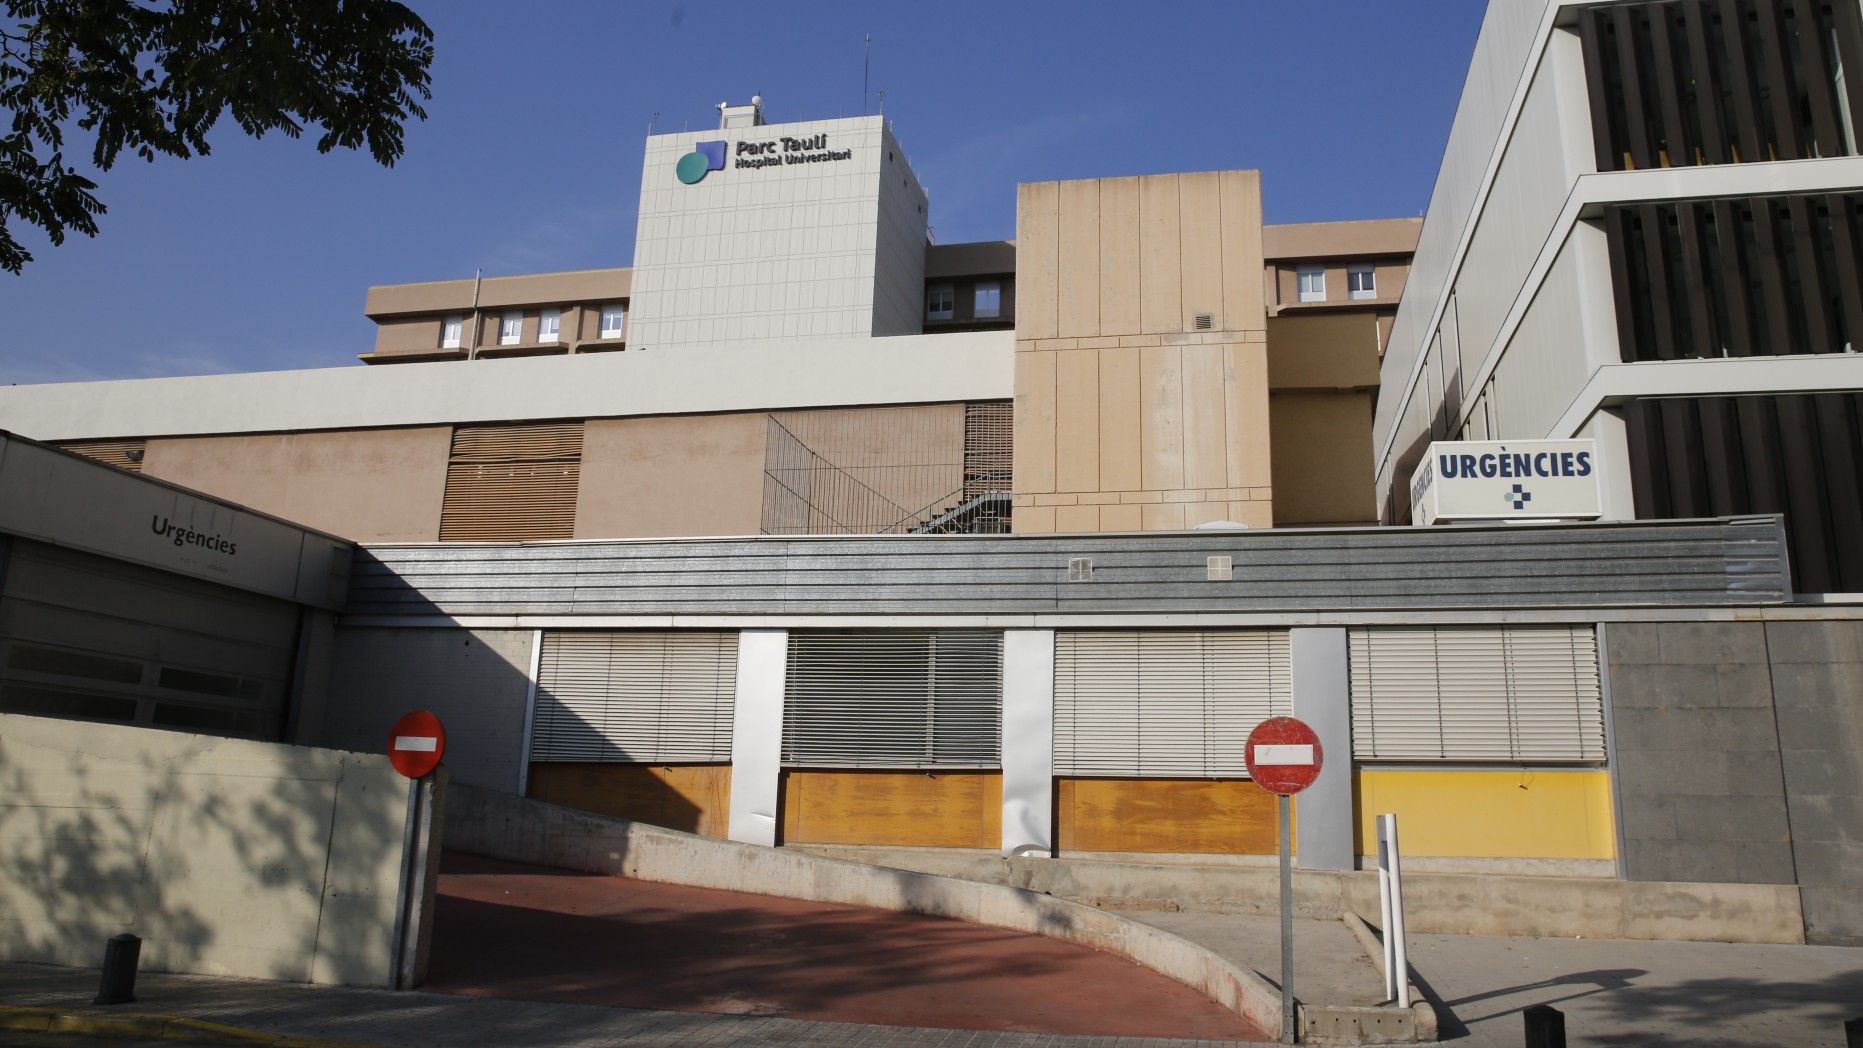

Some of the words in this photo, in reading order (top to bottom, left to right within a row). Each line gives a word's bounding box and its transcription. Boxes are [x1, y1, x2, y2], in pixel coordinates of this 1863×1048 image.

[736, 140, 777, 156] Parc
[780, 133, 828, 152] Taulí
[735, 154, 783, 169] Hospital
[785, 149, 852, 166] Universitari
[1439, 446, 1592, 479] URGÈNCIES
[151, 514, 237, 556] Urgències
